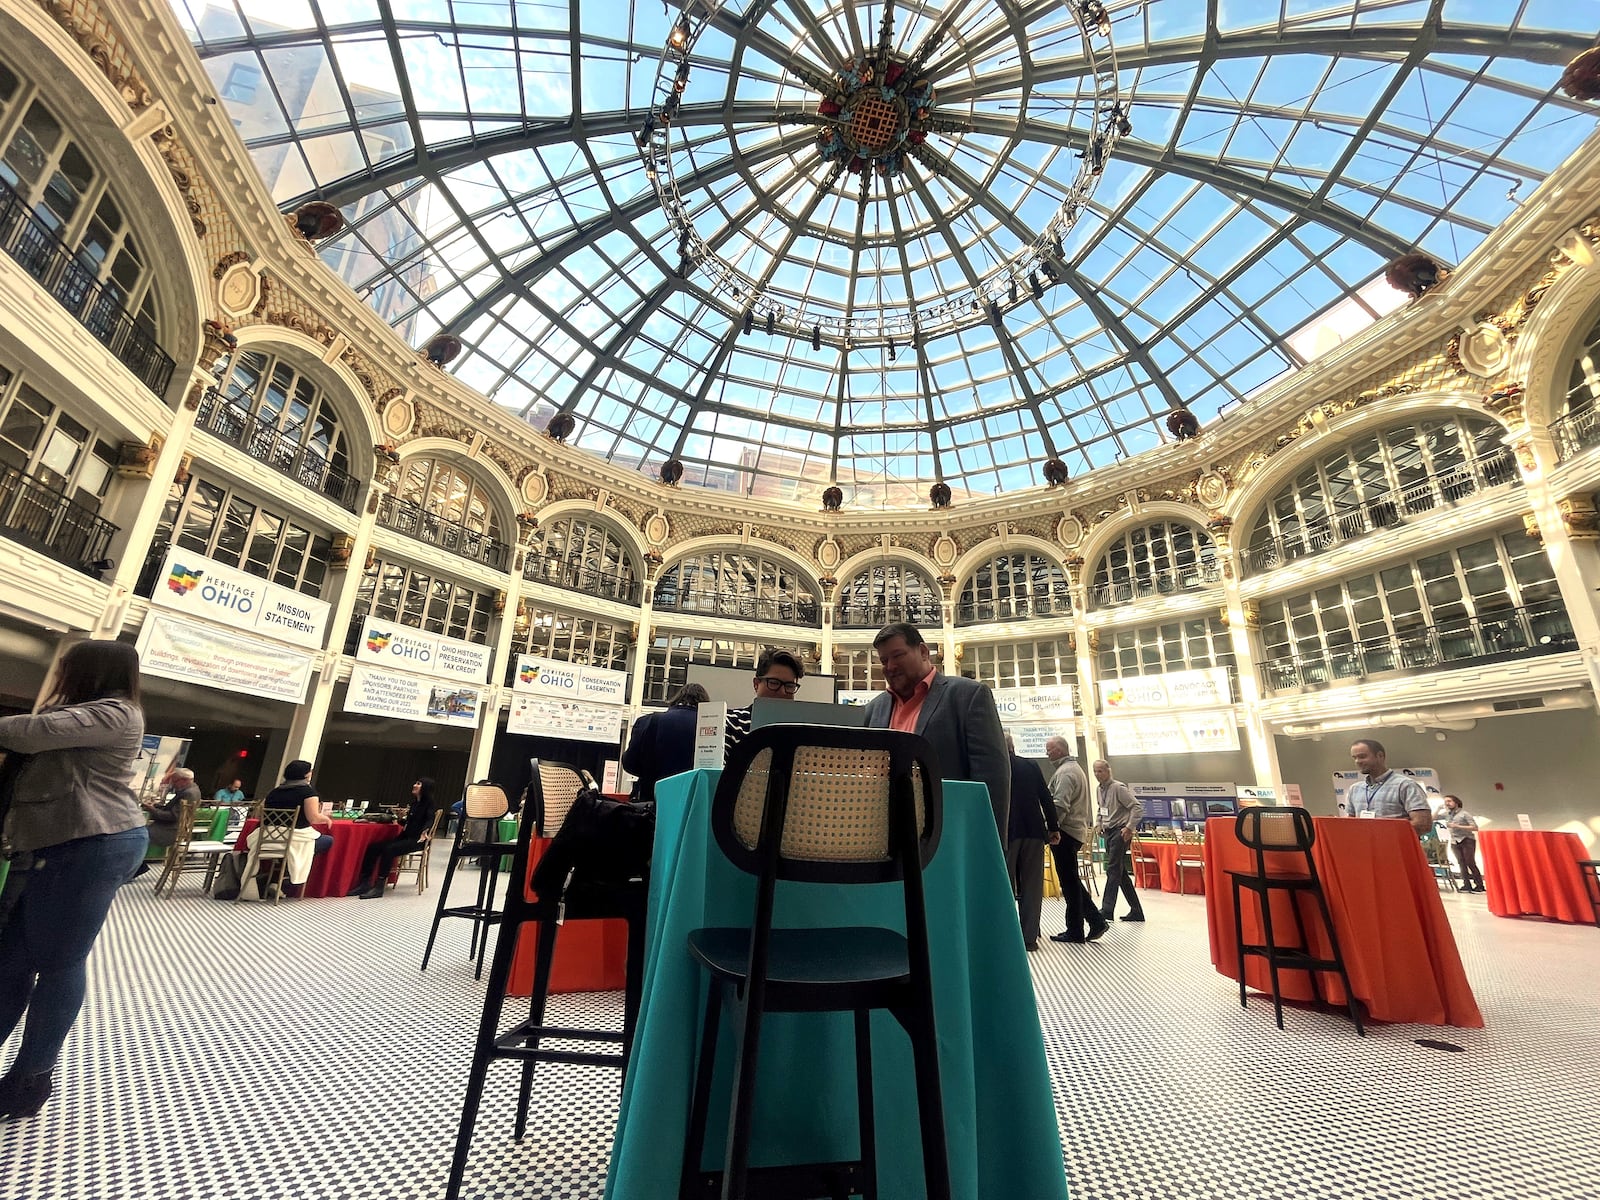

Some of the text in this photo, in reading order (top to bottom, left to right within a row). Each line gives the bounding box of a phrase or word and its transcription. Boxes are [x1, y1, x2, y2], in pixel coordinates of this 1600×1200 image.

[206, 575, 256, 598] HERITAGE
[201, 585, 253, 613] OHIO
[276, 602, 311, 620] MISSION
[264, 611, 316, 634] STATEMENT
[394, 636, 432, 650] HERITAGE
[391, 643, 431, 662] OHIO
[441, 645, 483, 660] OHIO HISTORIC
[149, 659, 187, 672] commercial
[439, 653, 483, 668] PRESERVATION
[443, 662, 477, 675] TAX CREDIT
[541, 668, 575, 679] HERITAGE
[369, 673, 386, 681] THANK
[387, 677, 399, 685] YOU
[540, 674, 574, 688] OHIO
[581, 676, 621, 688] CONSERVATION
[376, 690, 406, 700] ATTENDEES
[585, 684, 616, 694] EASEMENTS
[366, 695, 388, 704] MAKING
[388, 698, 400, 706] OUR
[1126, 691, 1162, 703] OHIO
[354, 700, 390, 712] CONFERENCE
[396, 707, 420, 716] SUCCESS
[996, 702, 1017, 712] HIO
[1415, 769, 1432, 777] RAM
